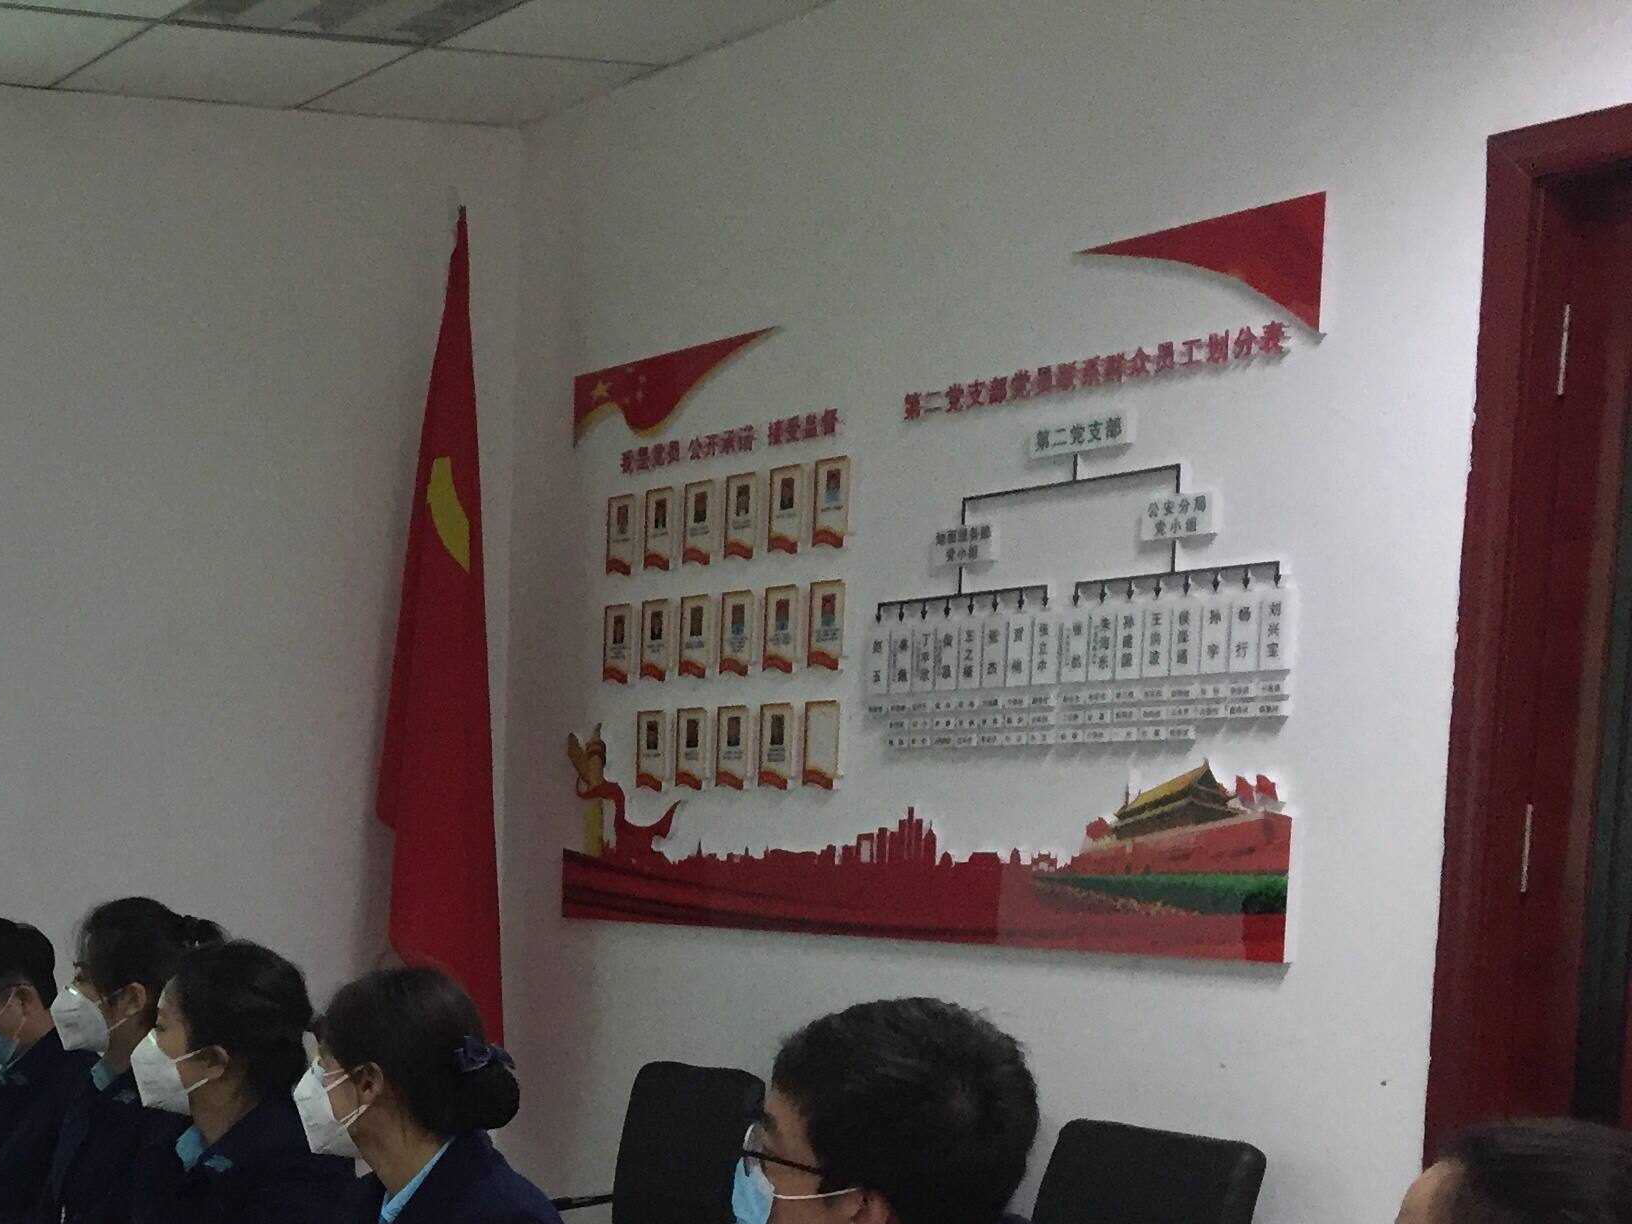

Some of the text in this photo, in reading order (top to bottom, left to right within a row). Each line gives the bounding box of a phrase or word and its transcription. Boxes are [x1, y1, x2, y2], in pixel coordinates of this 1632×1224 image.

[1034, 415, 1123, 452] 第二党支部
